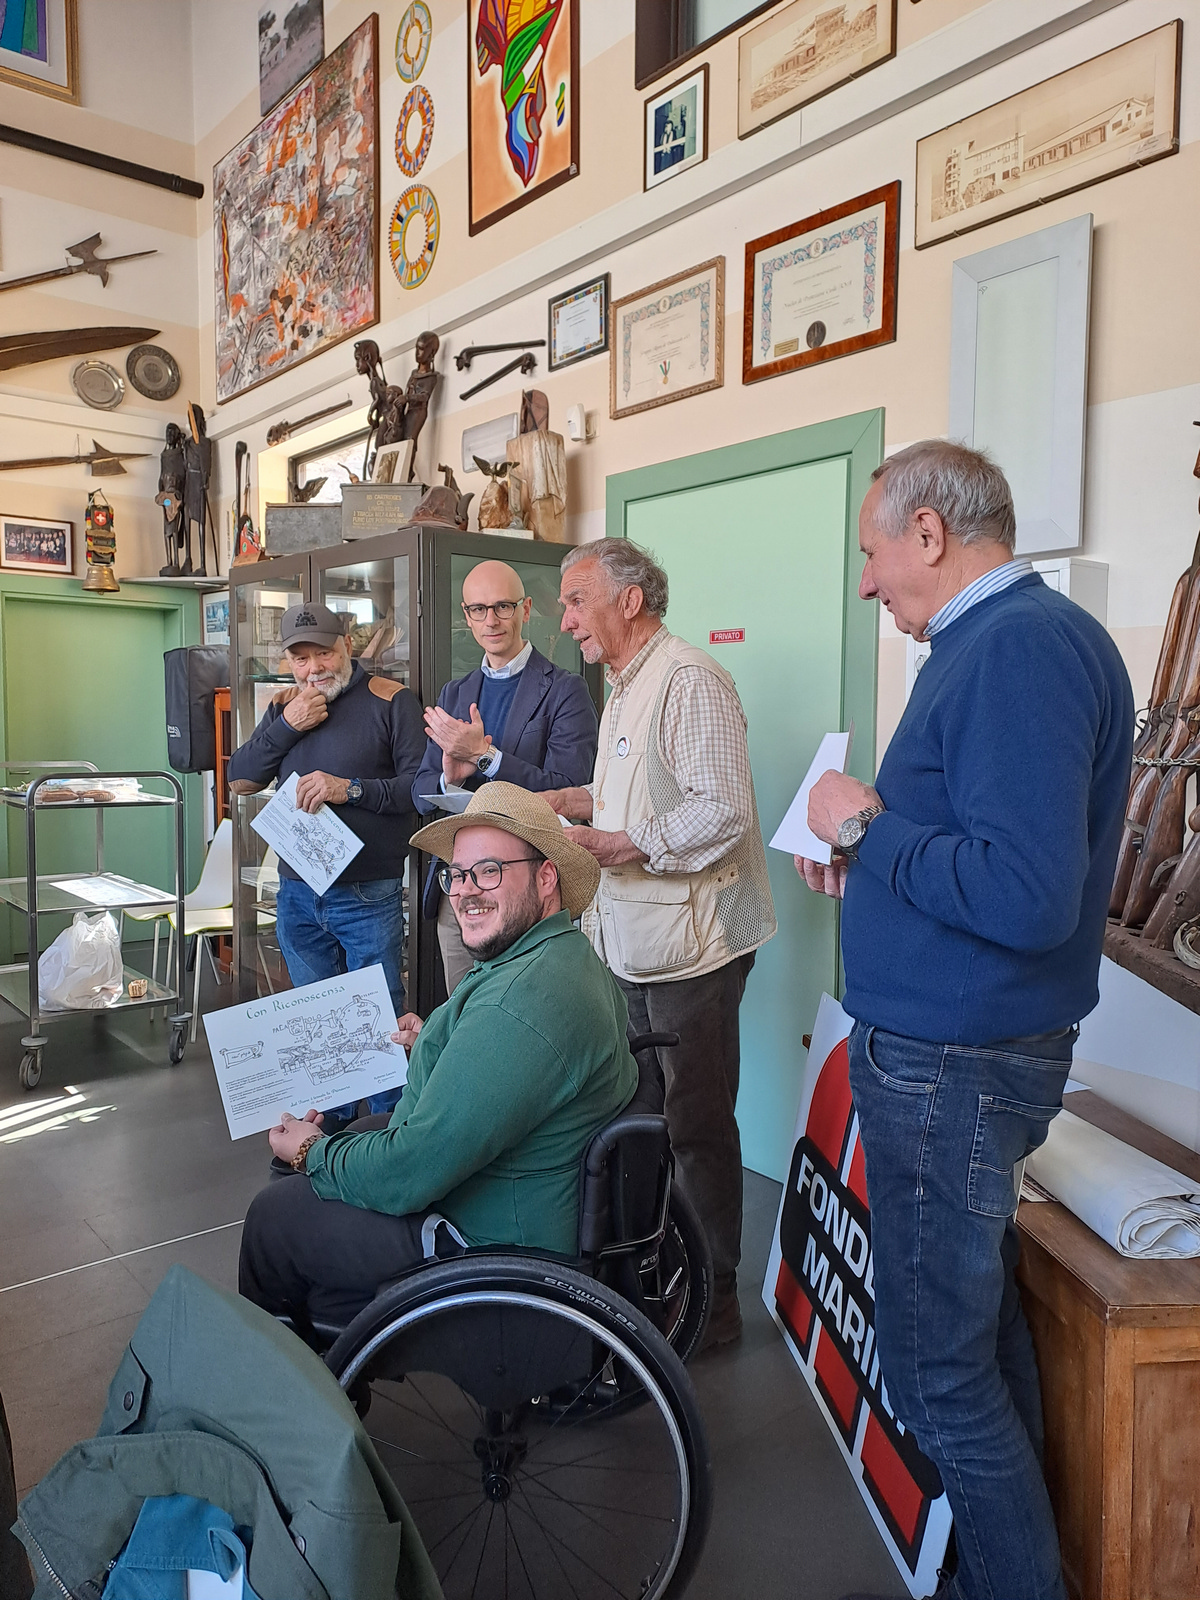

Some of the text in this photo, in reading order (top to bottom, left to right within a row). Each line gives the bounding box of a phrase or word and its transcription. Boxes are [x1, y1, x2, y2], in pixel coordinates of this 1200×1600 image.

[714, 631, 741, 641] PRIVATO
[246, 986, 346, 1020] Con Riconoscenza
[543, 1276, 638, 1332] SCHWALBE
[701, 1283, 709, 1311] PLUS
